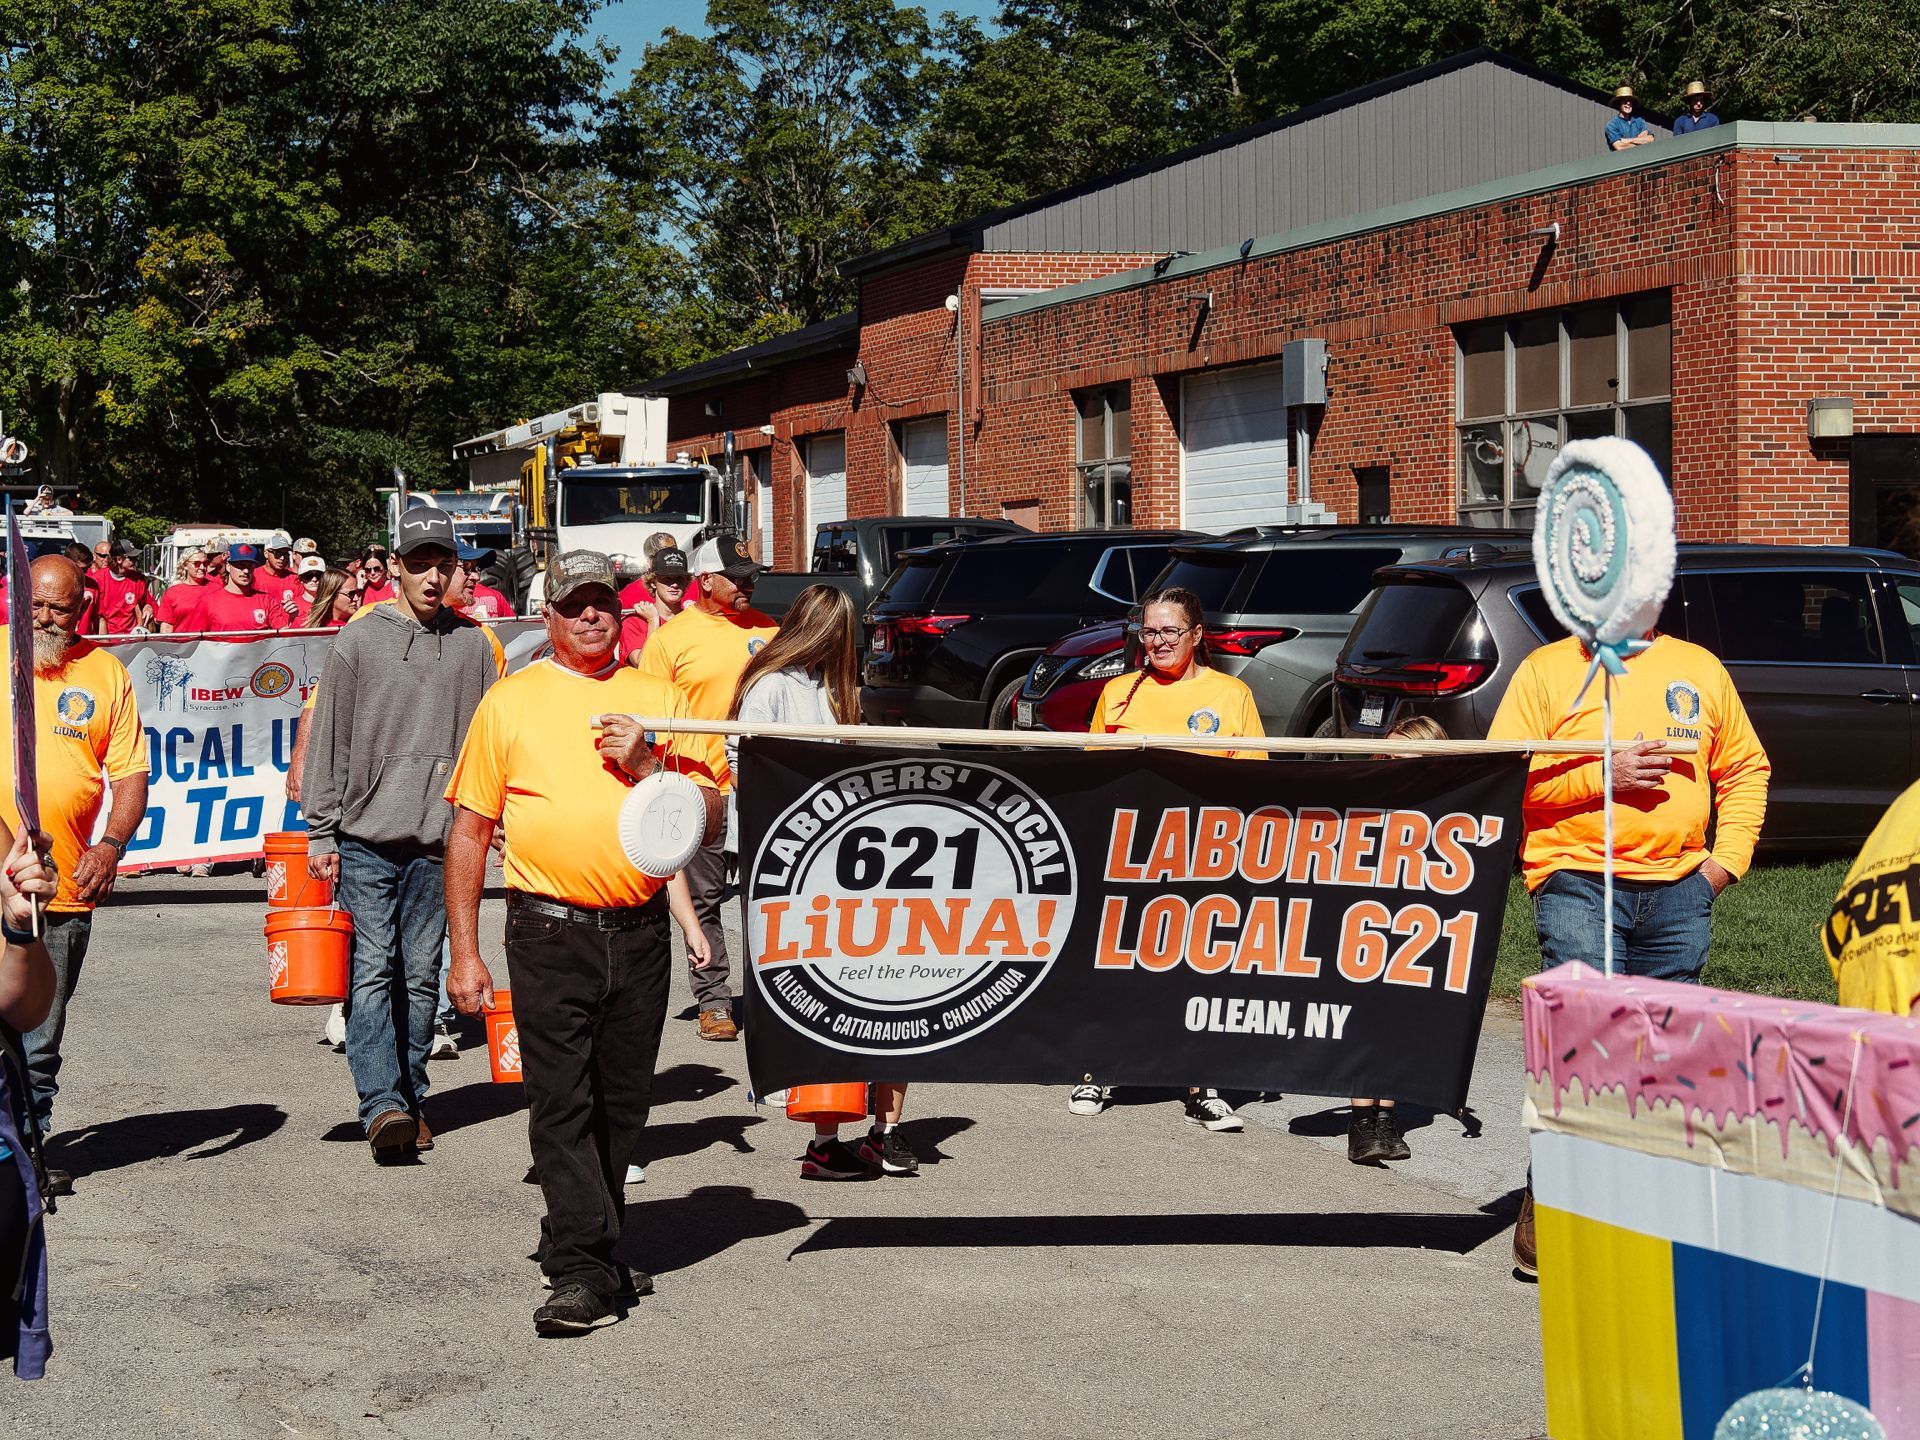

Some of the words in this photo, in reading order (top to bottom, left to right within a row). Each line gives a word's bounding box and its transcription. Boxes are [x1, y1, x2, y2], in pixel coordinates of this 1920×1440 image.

[191, 686, 245, 702] IBEW
[53, 726, 87, 741] LiUNA!
[143, 723, 255, 786] OCAL
[1666, 727, 1702, 740] LiUNA!
[758, 765, 971, 887] LABORERS'
[976, 779, 1068, 886] LOCAL
[1103, 805, 1504, 895] LABORERS'
[835, 826, 981, 891] 621
[758, 894, 1058, 966] LiUNA!
[1094, 894, 1322, 978] LOCAL
[1336, 900, 1479, 994] 621
[772, 968, 826, 1022] ALLEGANY
[831, 1013, 930, 1041] CATTARAUGUS
[942, 968, 1026, 1031] CHAUTAUQUA
[838, 965, 874, 981] Feel
[877, 965, 905, 980] the
[909, 964, 965, 980] Power
[1184, 996, 1296, 1040] OLEAN,
[1303, 1002, 1353, 1040] NY
